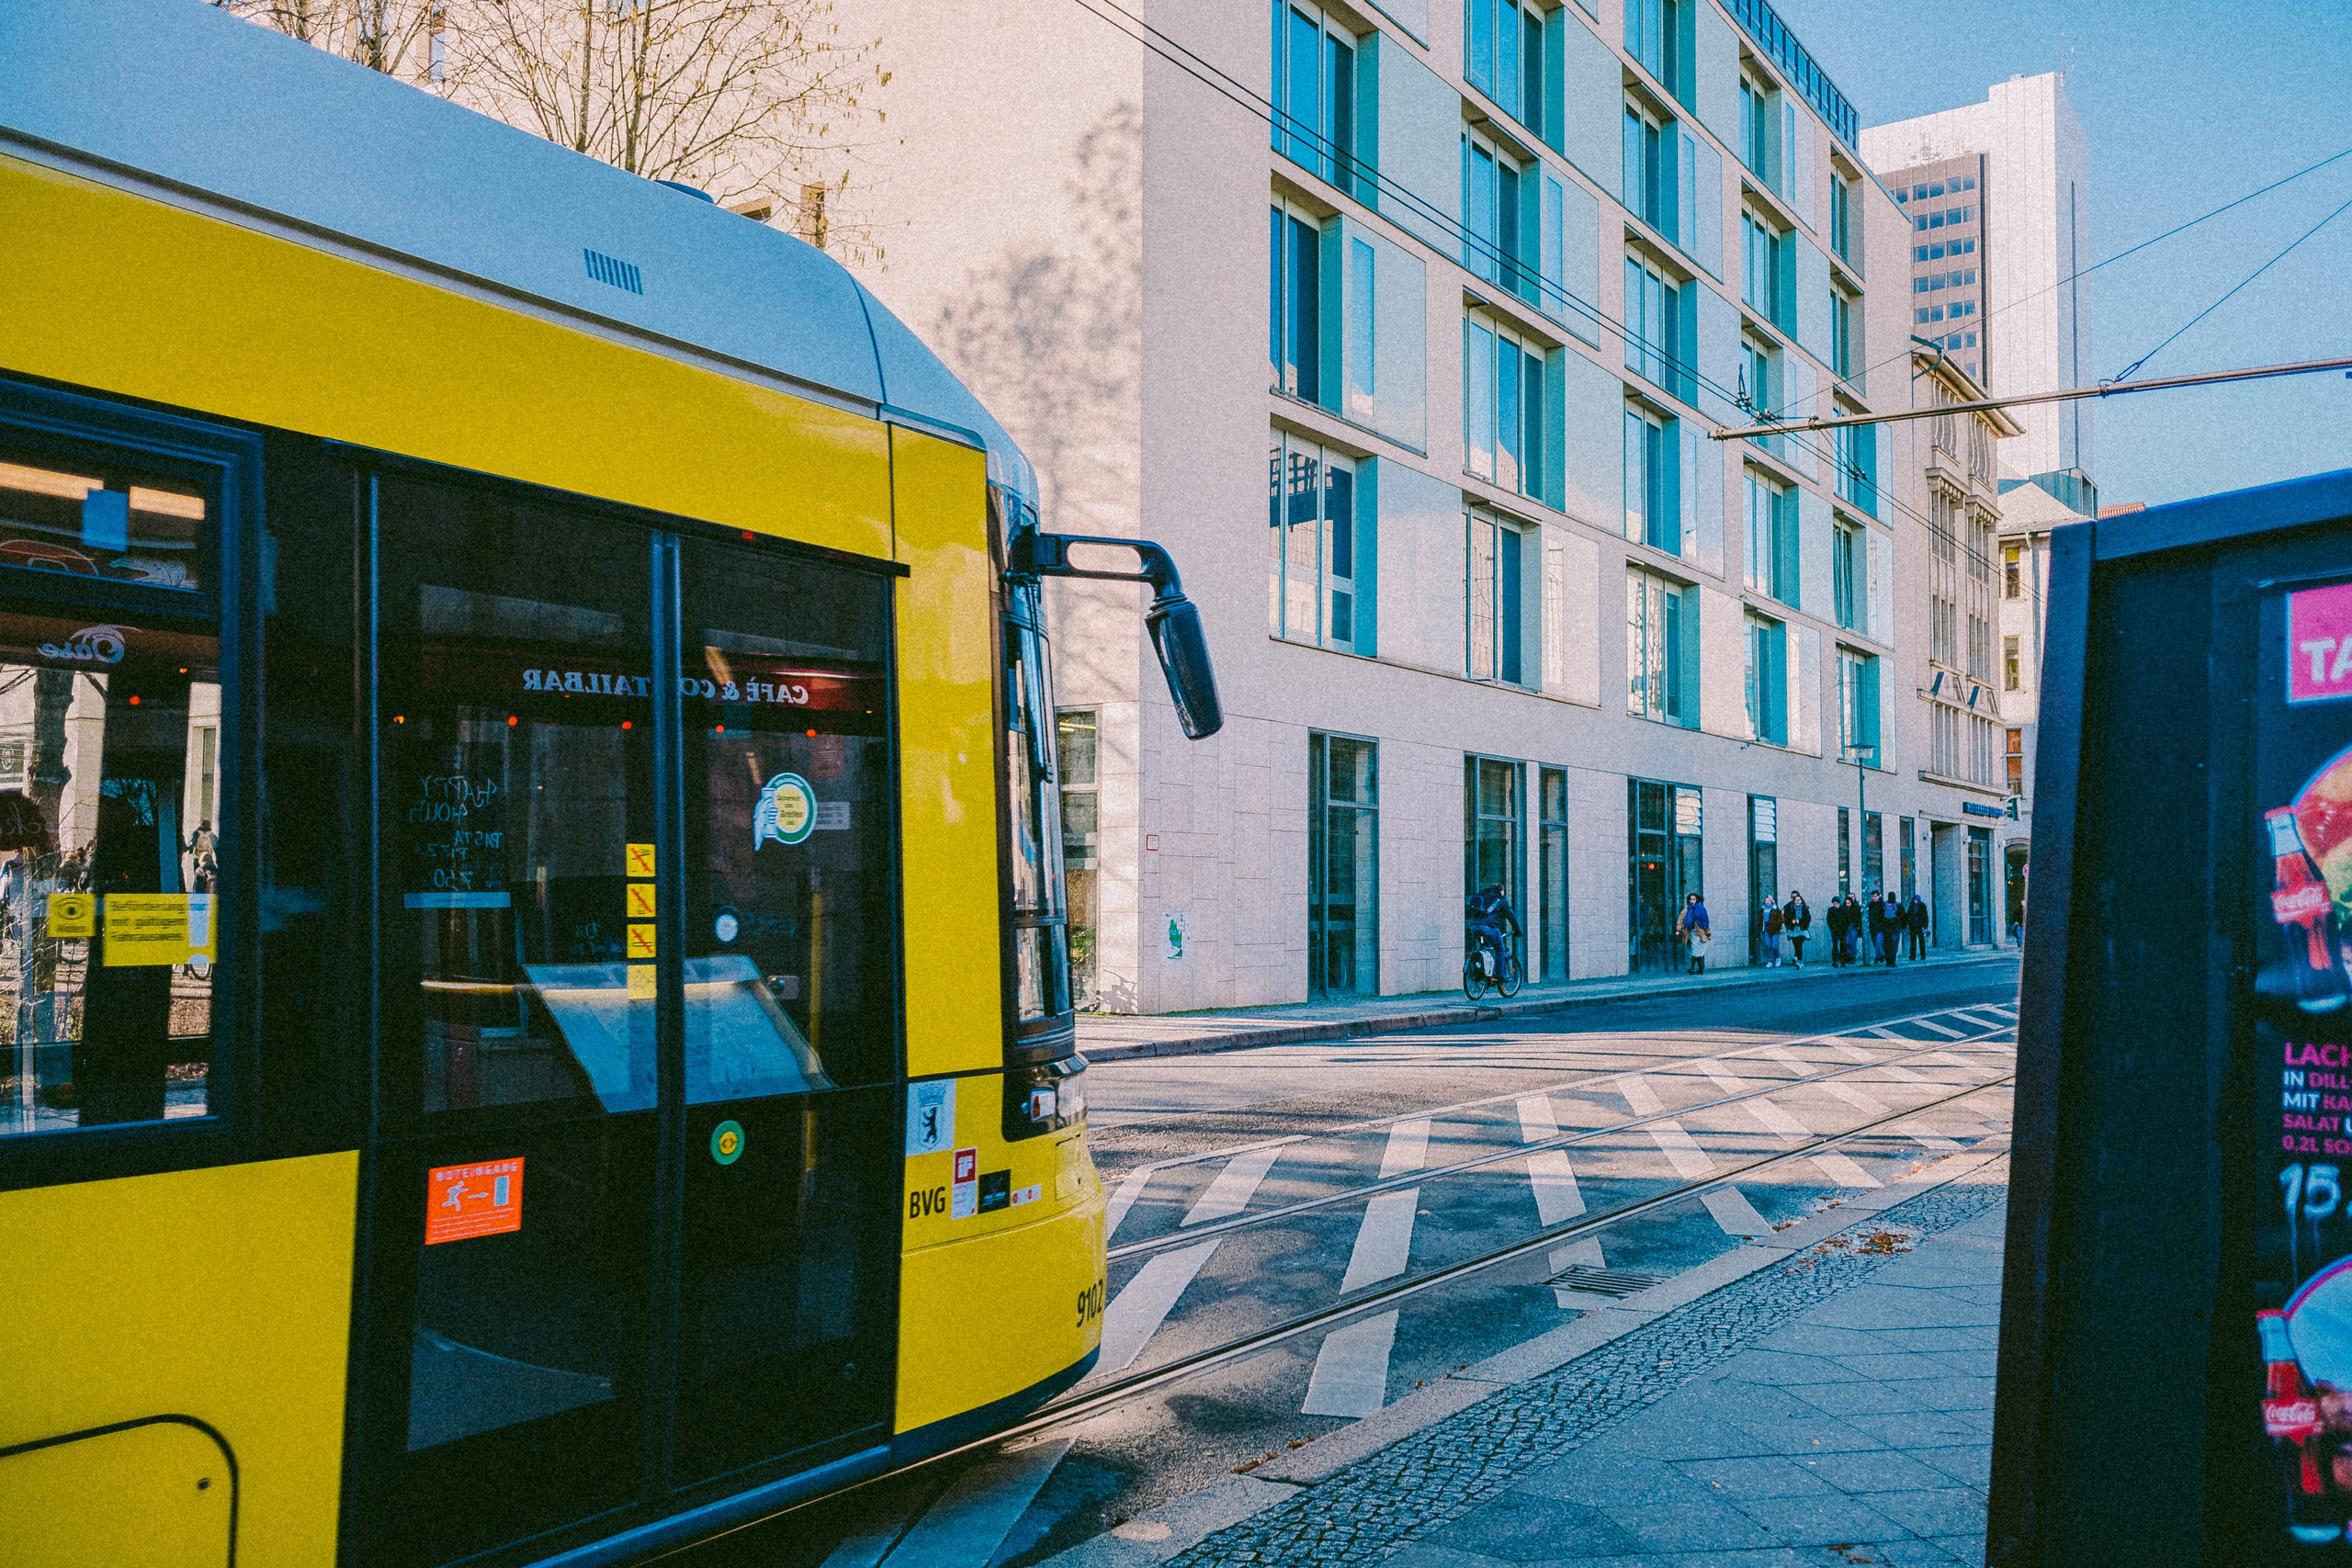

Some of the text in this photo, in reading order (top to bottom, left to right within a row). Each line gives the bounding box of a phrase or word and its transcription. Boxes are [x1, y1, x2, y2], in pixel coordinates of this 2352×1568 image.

[2283, 1071, 2304, 1087] IN
[2283, 1091, 2352, 1111] MIT KA
[2283, 1113, 2340, 1132] SALAT
[2324, 1138, 2352, 1155] SO
[910, 1186, 946, 1218] BVG
[1077, 1279, 1102, 1327] 9102
